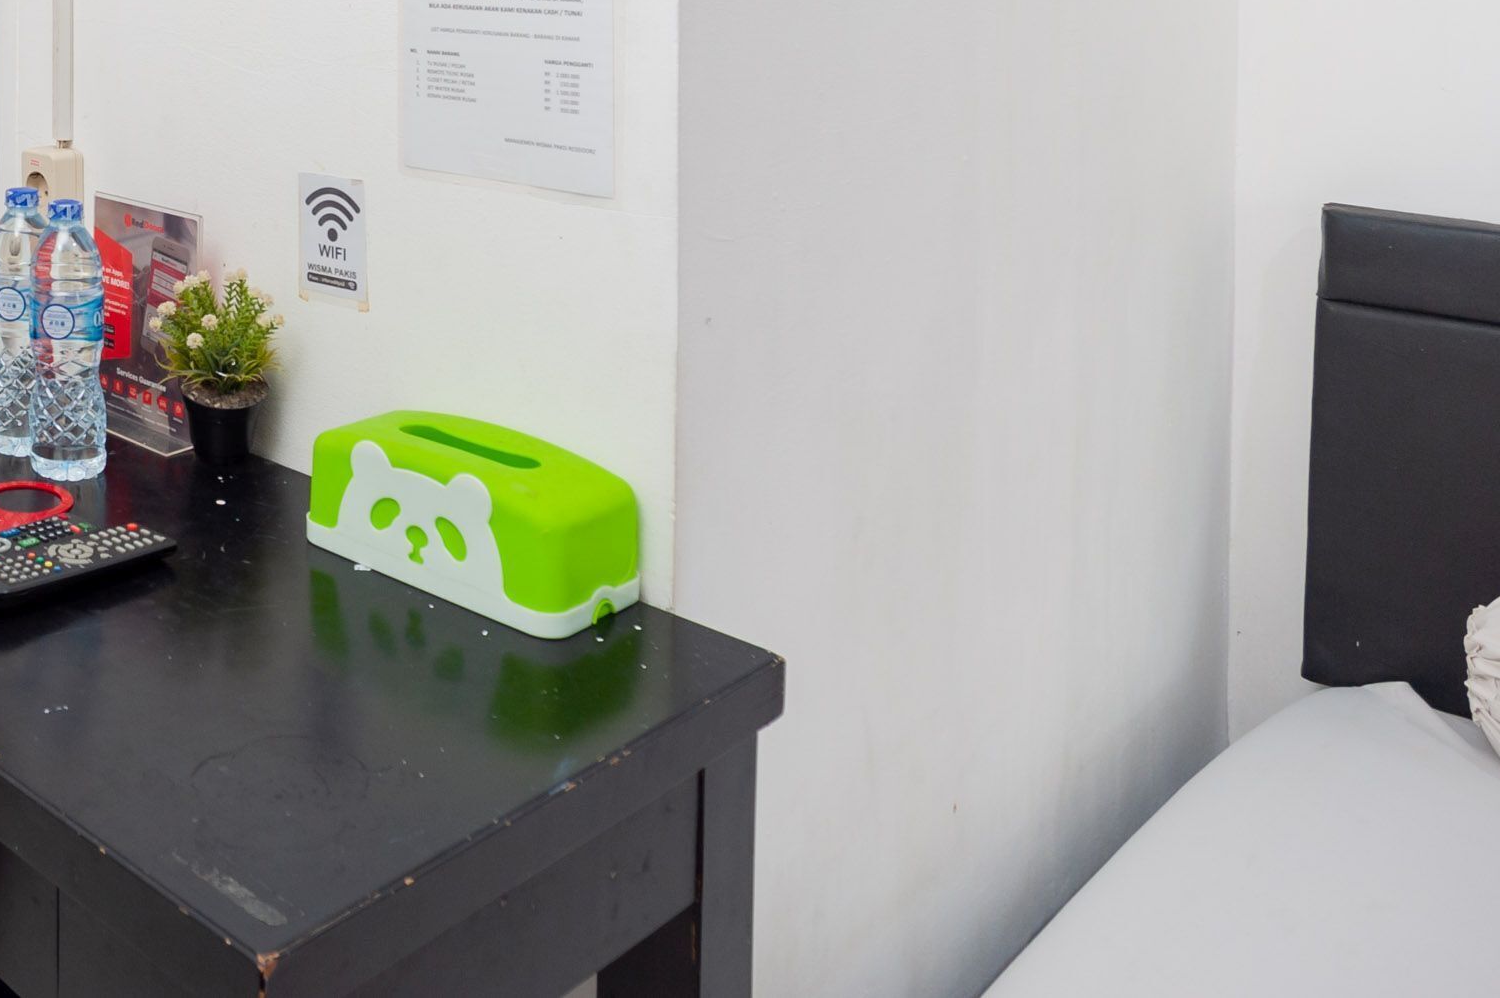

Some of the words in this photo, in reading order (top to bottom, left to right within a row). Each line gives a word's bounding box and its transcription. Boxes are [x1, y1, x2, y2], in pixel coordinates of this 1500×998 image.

[318, 243, 347, 262] WIFI
[307, 262, 334, 275] WISMA
[334, 267, 357, 280] PAKIS
